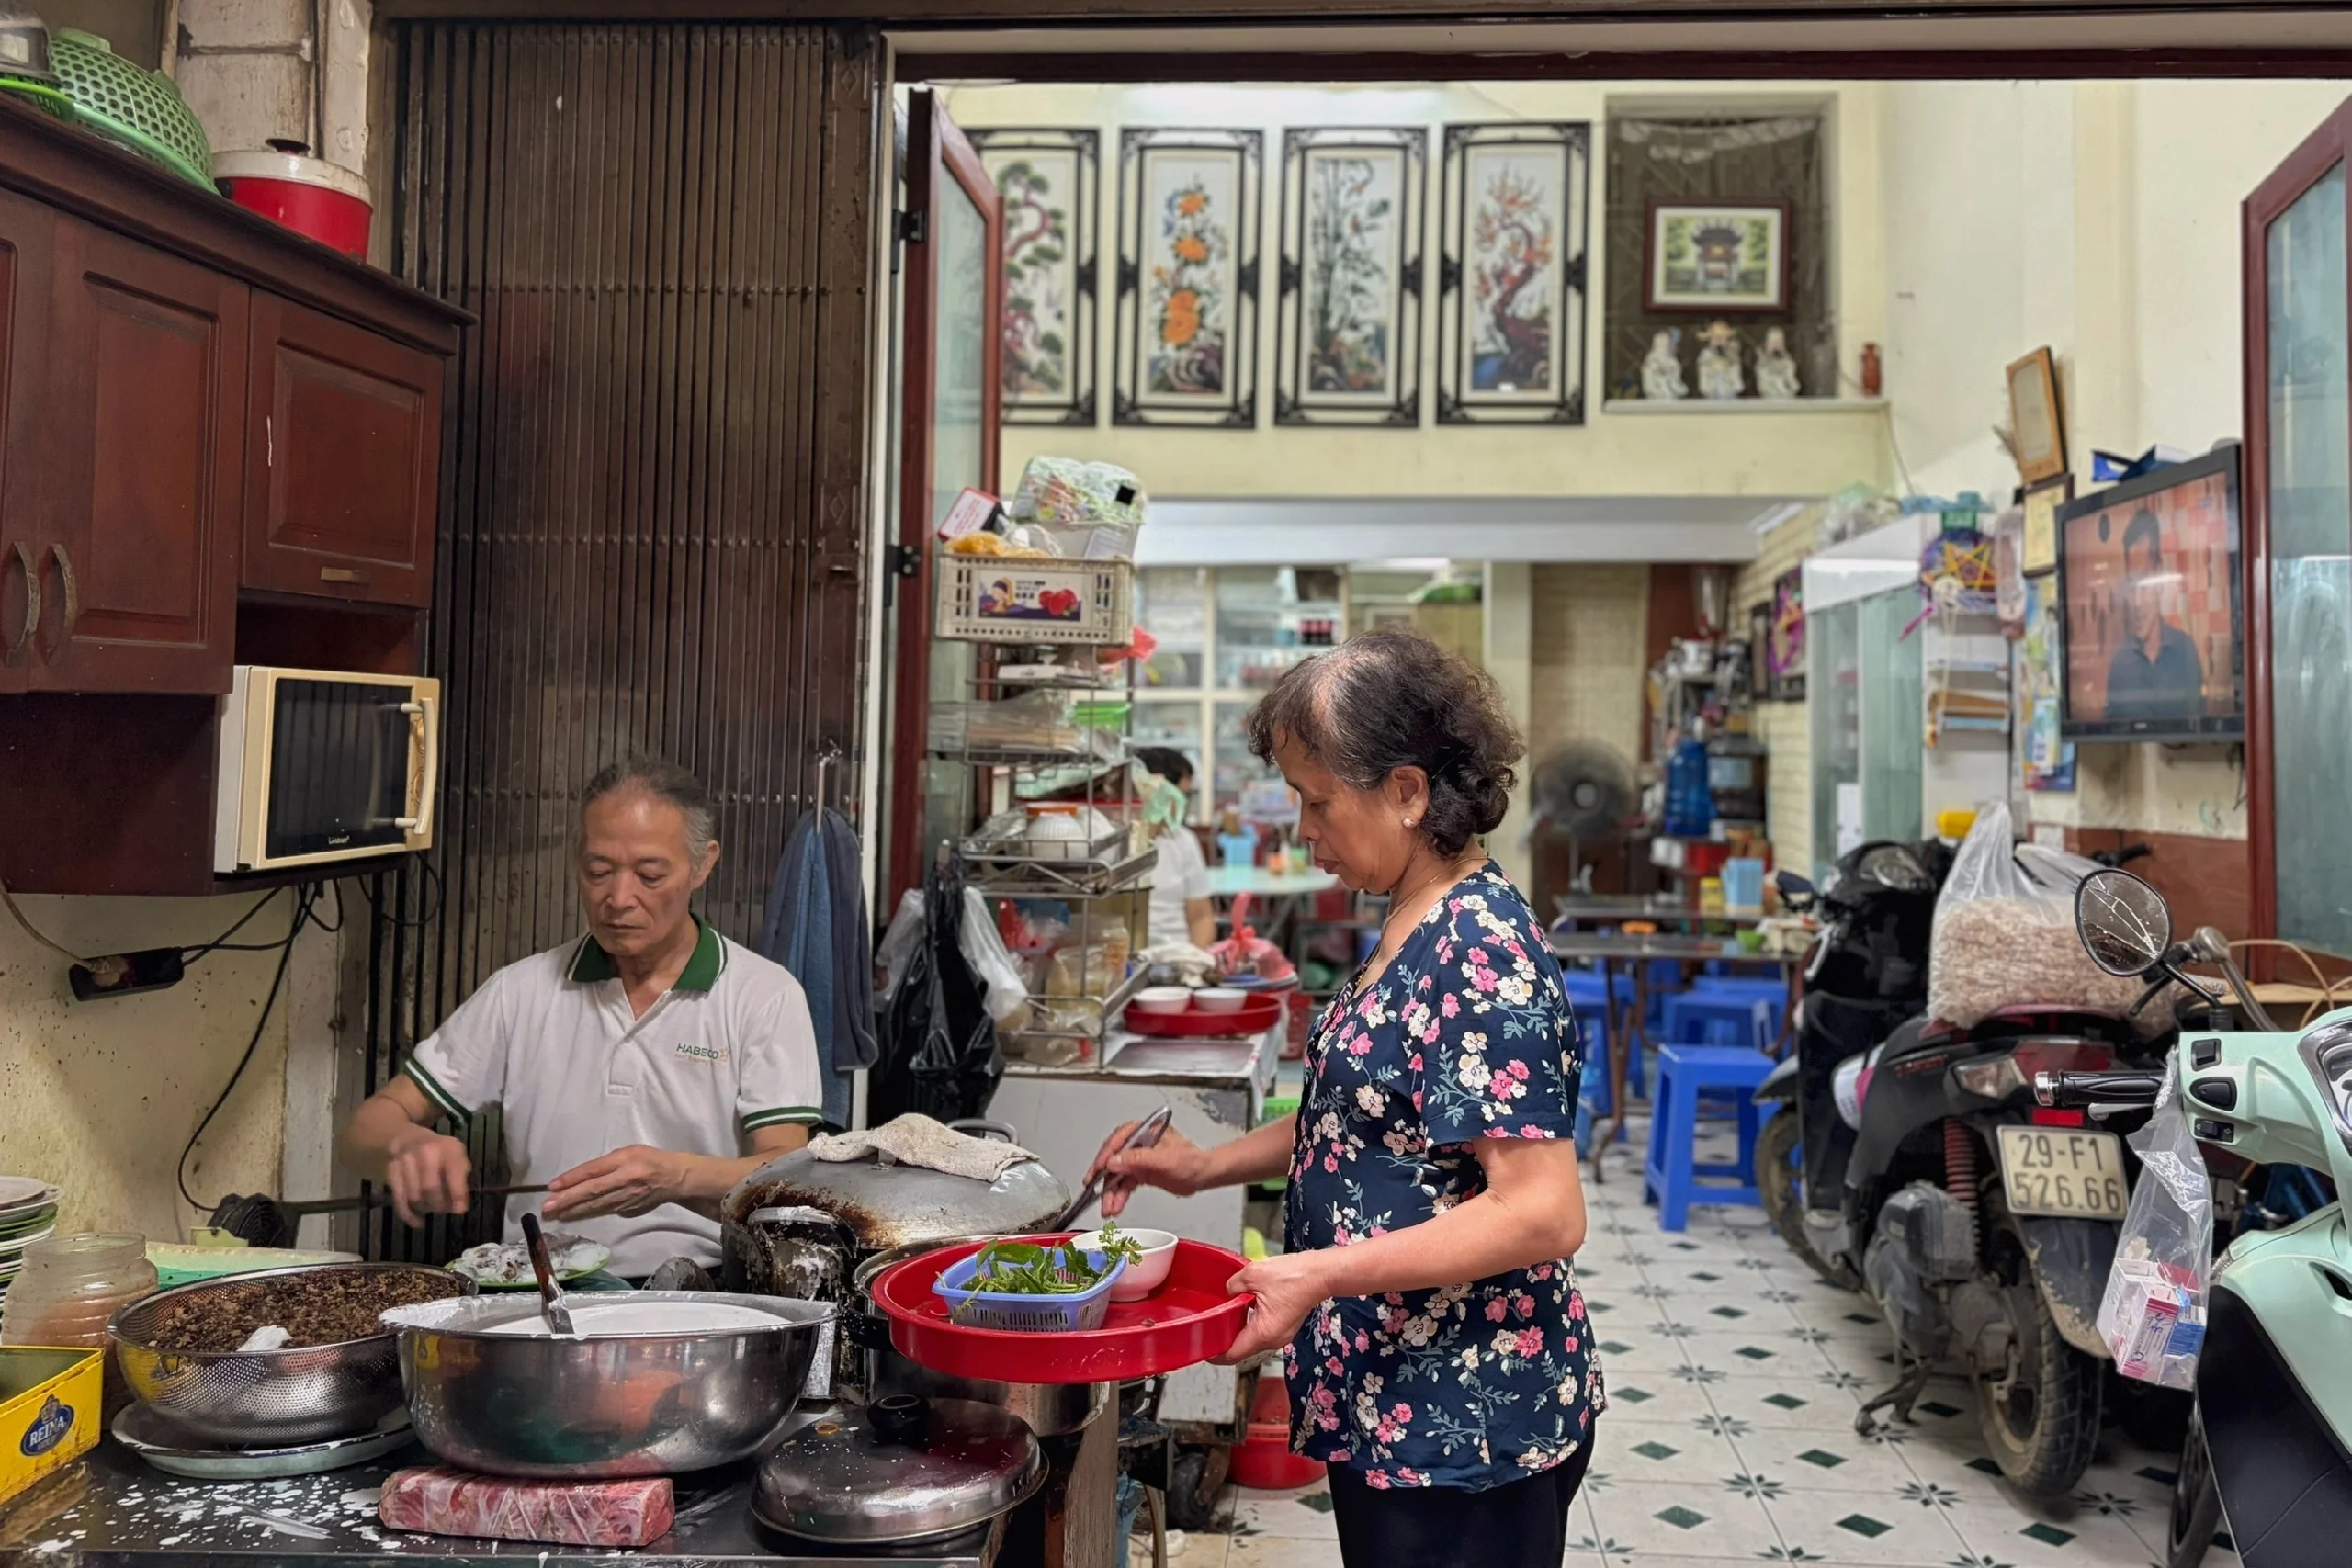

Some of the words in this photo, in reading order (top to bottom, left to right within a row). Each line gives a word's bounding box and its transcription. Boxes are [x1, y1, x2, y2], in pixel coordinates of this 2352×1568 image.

[676, 1043, 719, 1060] HABECO
[2018, 1134, 2103, 1171] 29-F1
[2014, 1172, 2121, 1212] 526.66
[29, 1416, 65, 1448] REINA
